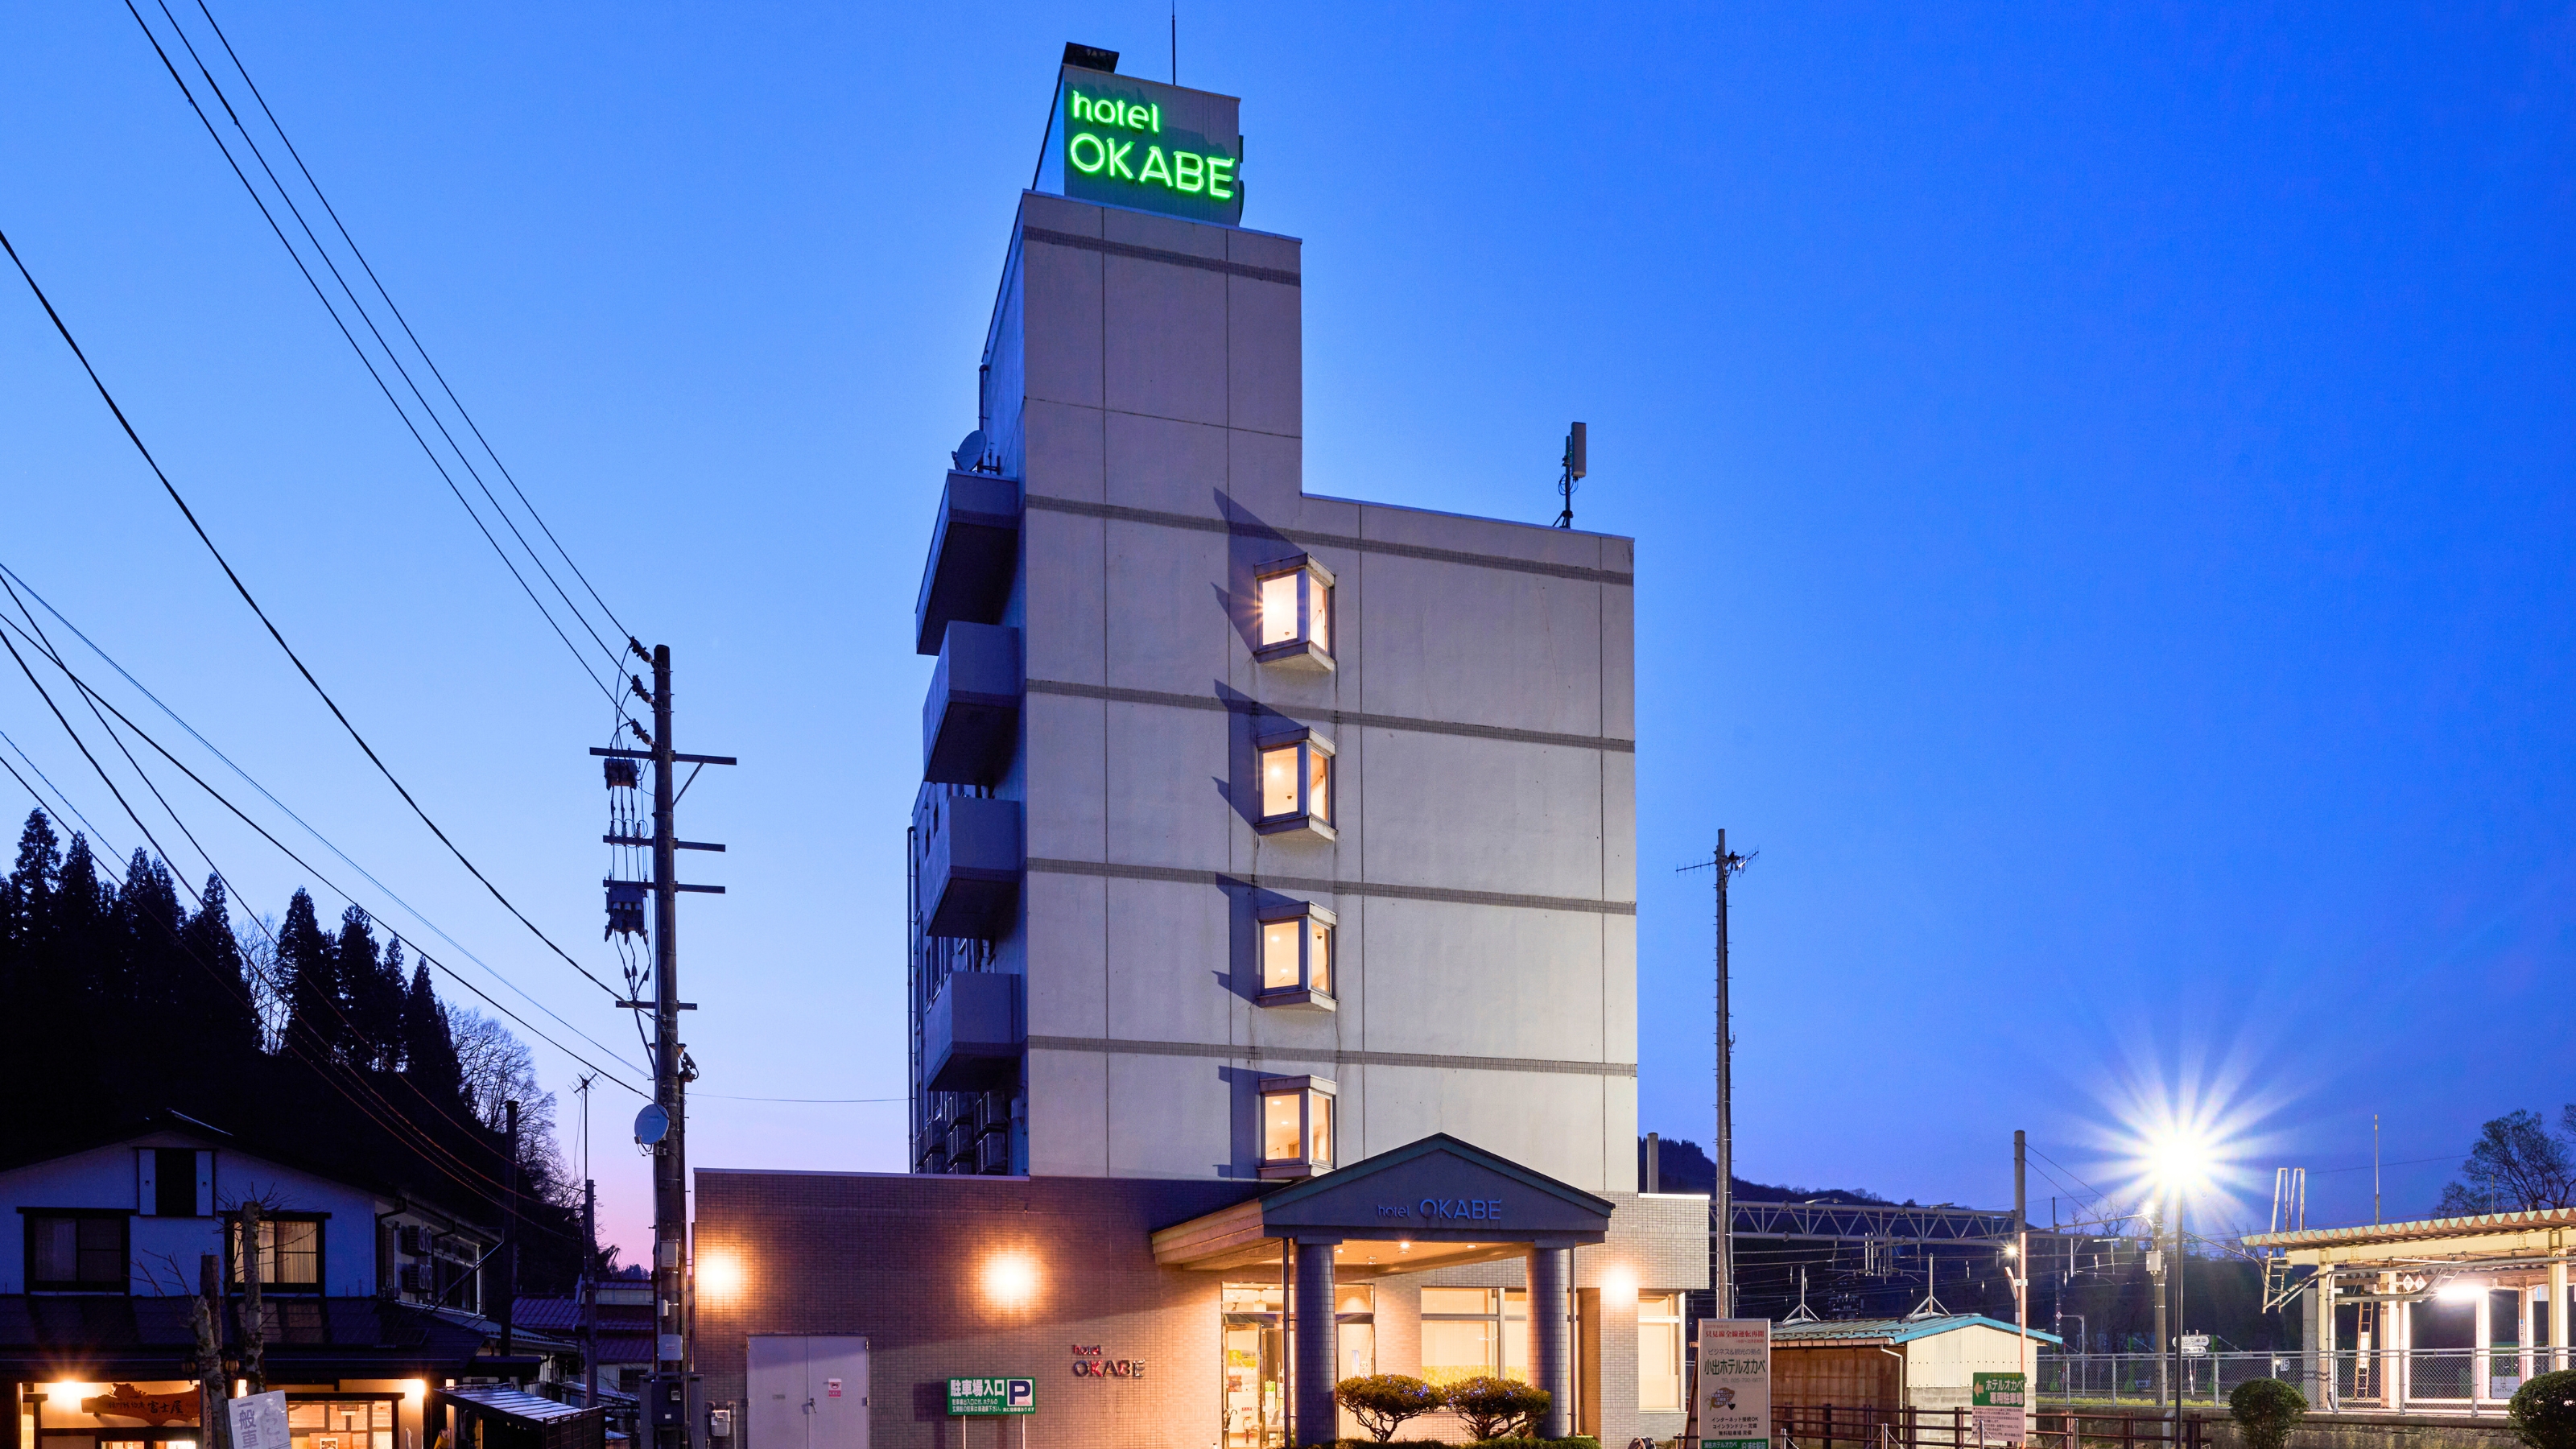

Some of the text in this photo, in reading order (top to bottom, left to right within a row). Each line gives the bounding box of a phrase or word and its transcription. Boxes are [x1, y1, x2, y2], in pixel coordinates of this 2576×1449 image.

[1072, 89, 1159, 134] hotel
[1070, 132, 1236, 199] OKABE
[1377, 1199, 1501, 1220] hotel OKABE
[1706, 1330, 1765, 1338] 只見線全線運転再開
[1072, 1344, 1101, 1356] hotel
[1072, 1358, 1146, 1377] OKABE
[1704, 1358, 1765, 1375] 小出ホテルオカベ
[950, 1379, 1031, 1405] 駐車場入口 P
[1985, 1379, 2024, 1391] ホテルオカベ
[147, 1400, 184, 1414] 富士屋
[1989, 1392, 2024, 1405] 専用駐車場
[237, 1402, 259, 1449] 一般車
